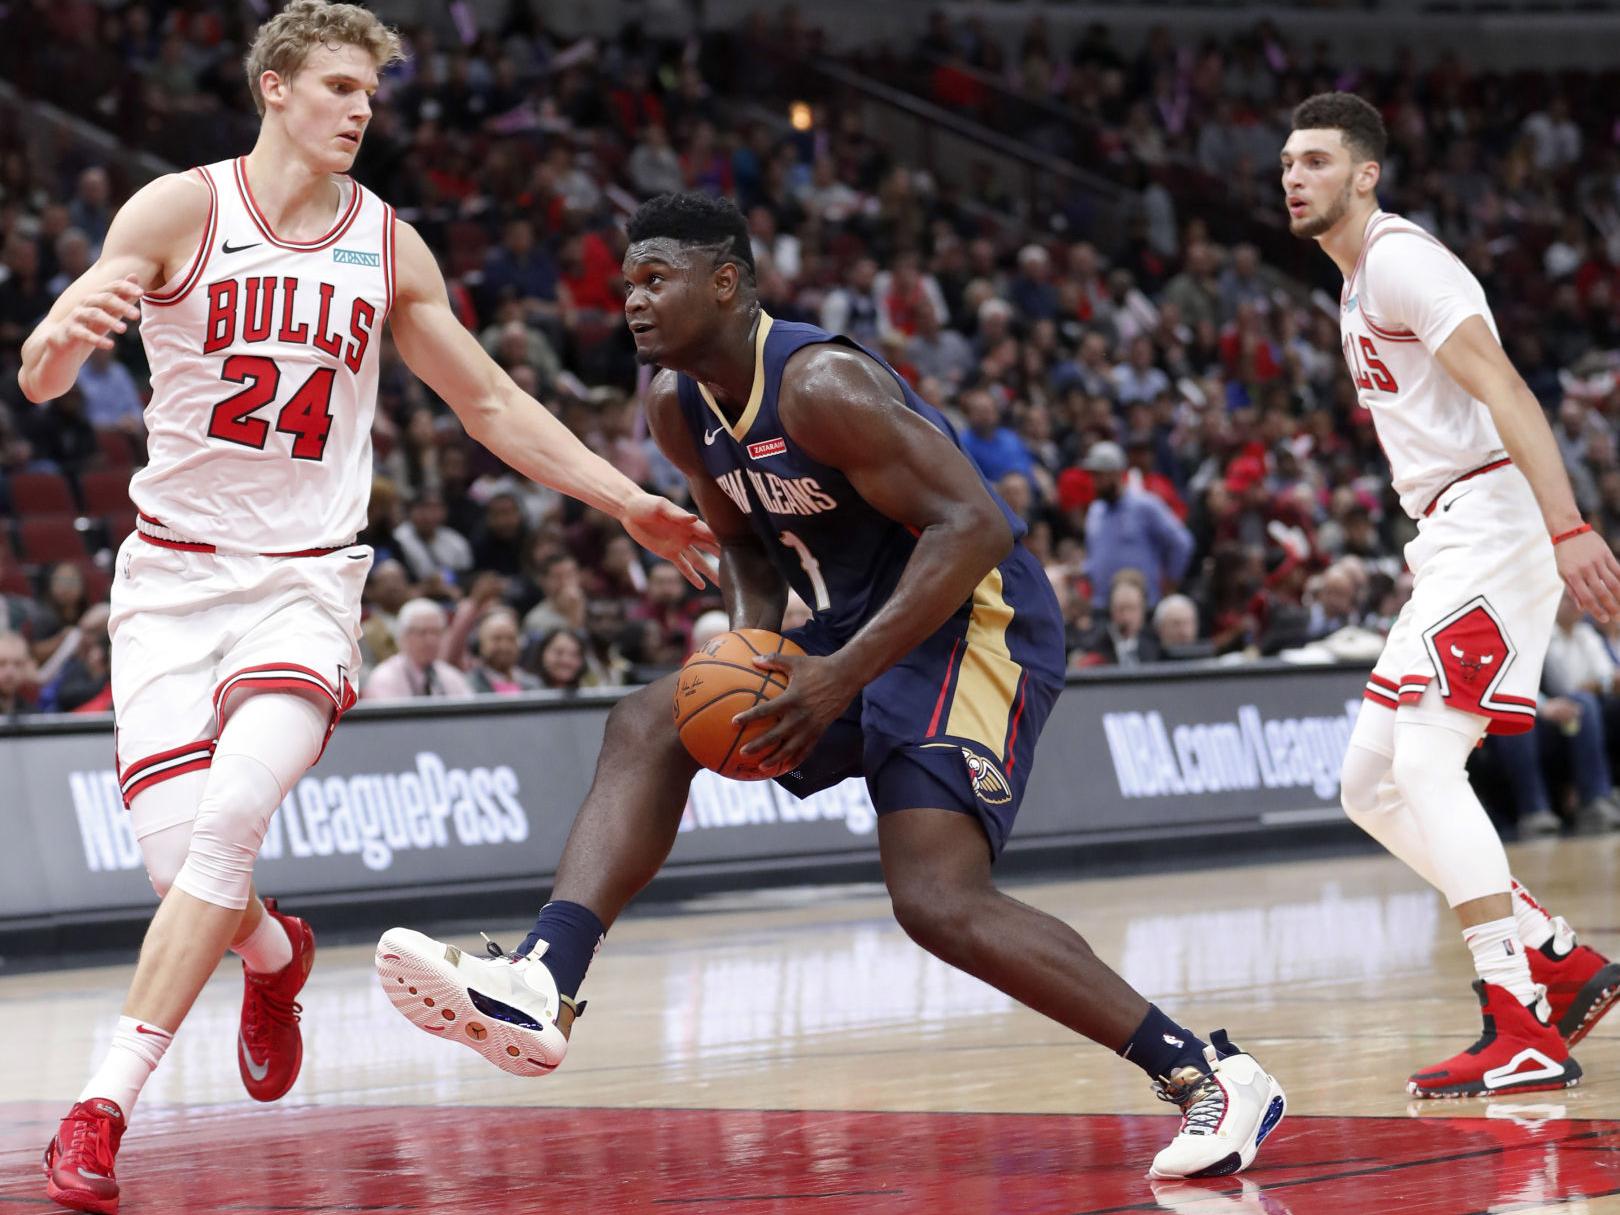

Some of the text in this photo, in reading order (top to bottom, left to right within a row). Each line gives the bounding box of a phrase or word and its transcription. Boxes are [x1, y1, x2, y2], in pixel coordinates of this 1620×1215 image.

[203, 276, 375, 375] BULLS
[207, 355, 336, 461] 24
[779, 531, 830, 611] 1
